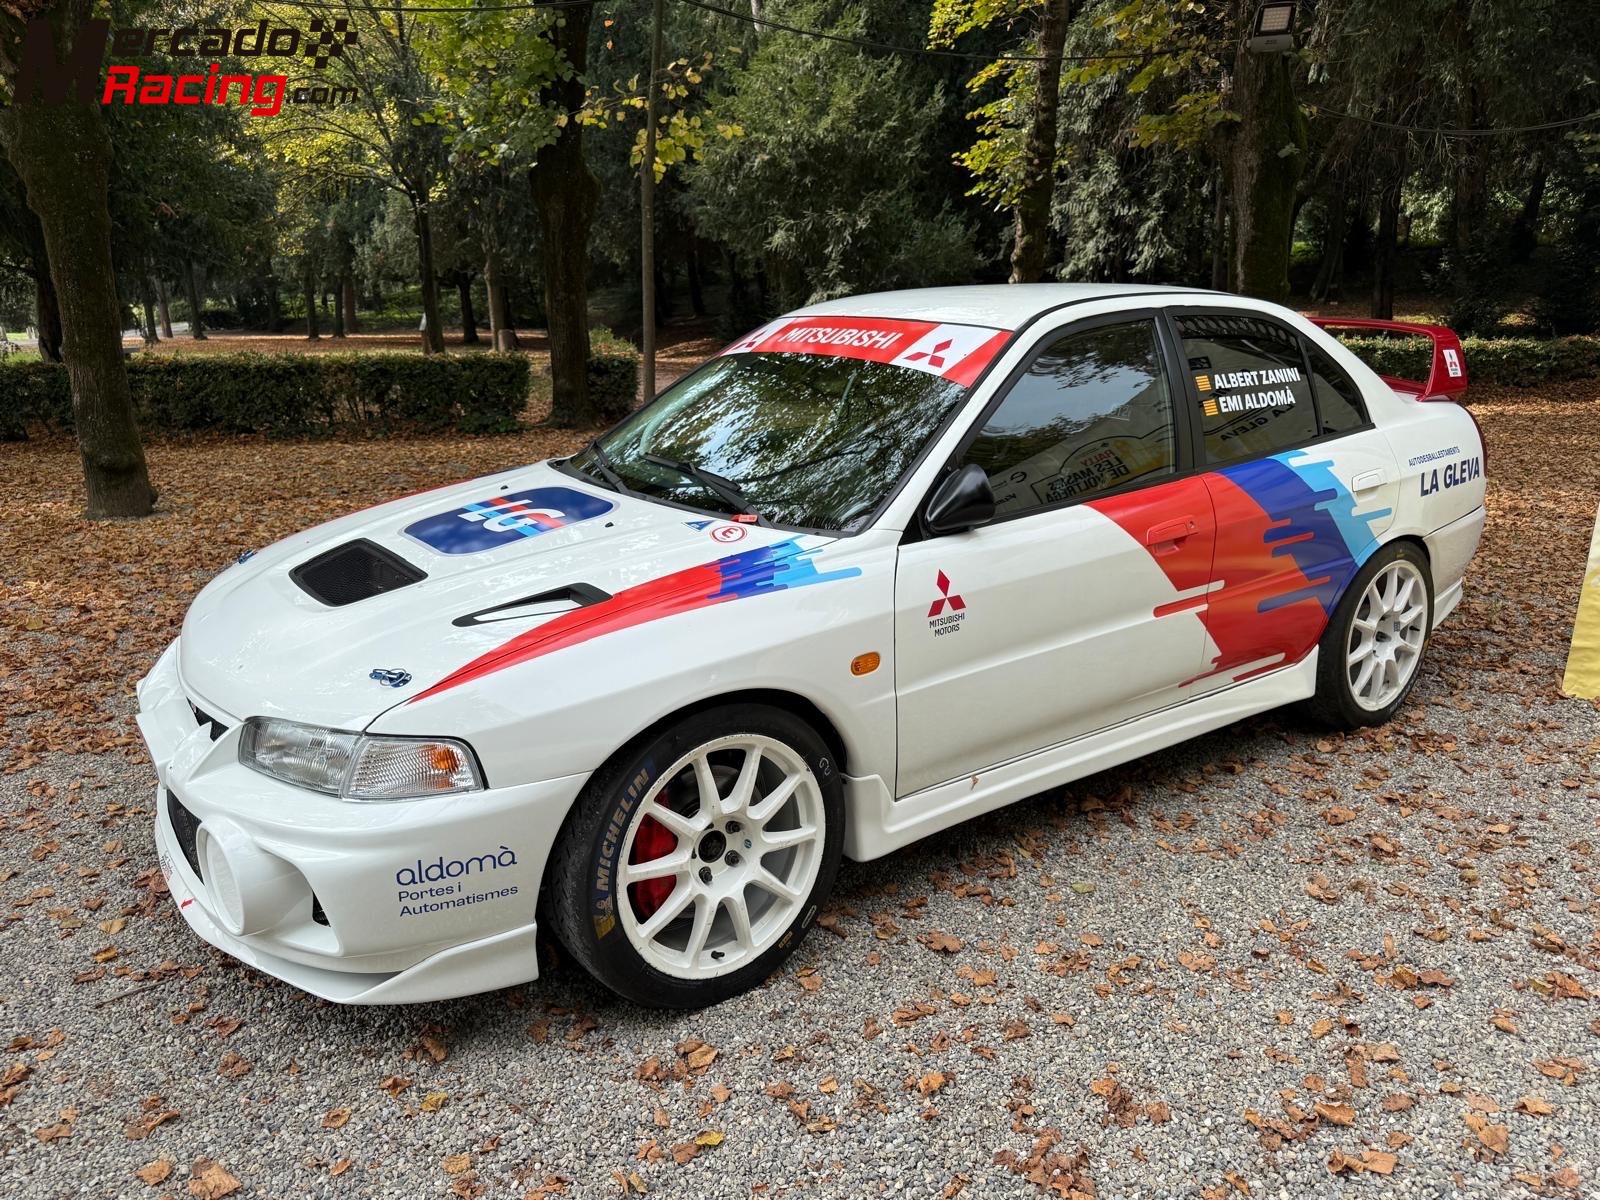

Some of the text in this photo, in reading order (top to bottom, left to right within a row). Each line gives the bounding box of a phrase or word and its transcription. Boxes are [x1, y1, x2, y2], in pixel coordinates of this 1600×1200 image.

[778, 327, 904, 350] MITSUBISHI
[1214, 367, 1301, 389] ALBERT ZANINI
[1218, 386, 1297, 413] EMI ALDOMÀ
[1408, 446, 1461, 467] AUTODESBALLESTAMENTS
[1420, 457, 1480, 497] LA GLEVA
[929, 612, 965, 629] MITSUBISHI
[934, 623, 960, 637] MOTORS
[596, 767, 650, 891] MICHELIN
[396, 845, 518, 885] aldomà
[398, 882, 462, 902] Portes i
[400, 886, 518, 917] Automatismes
